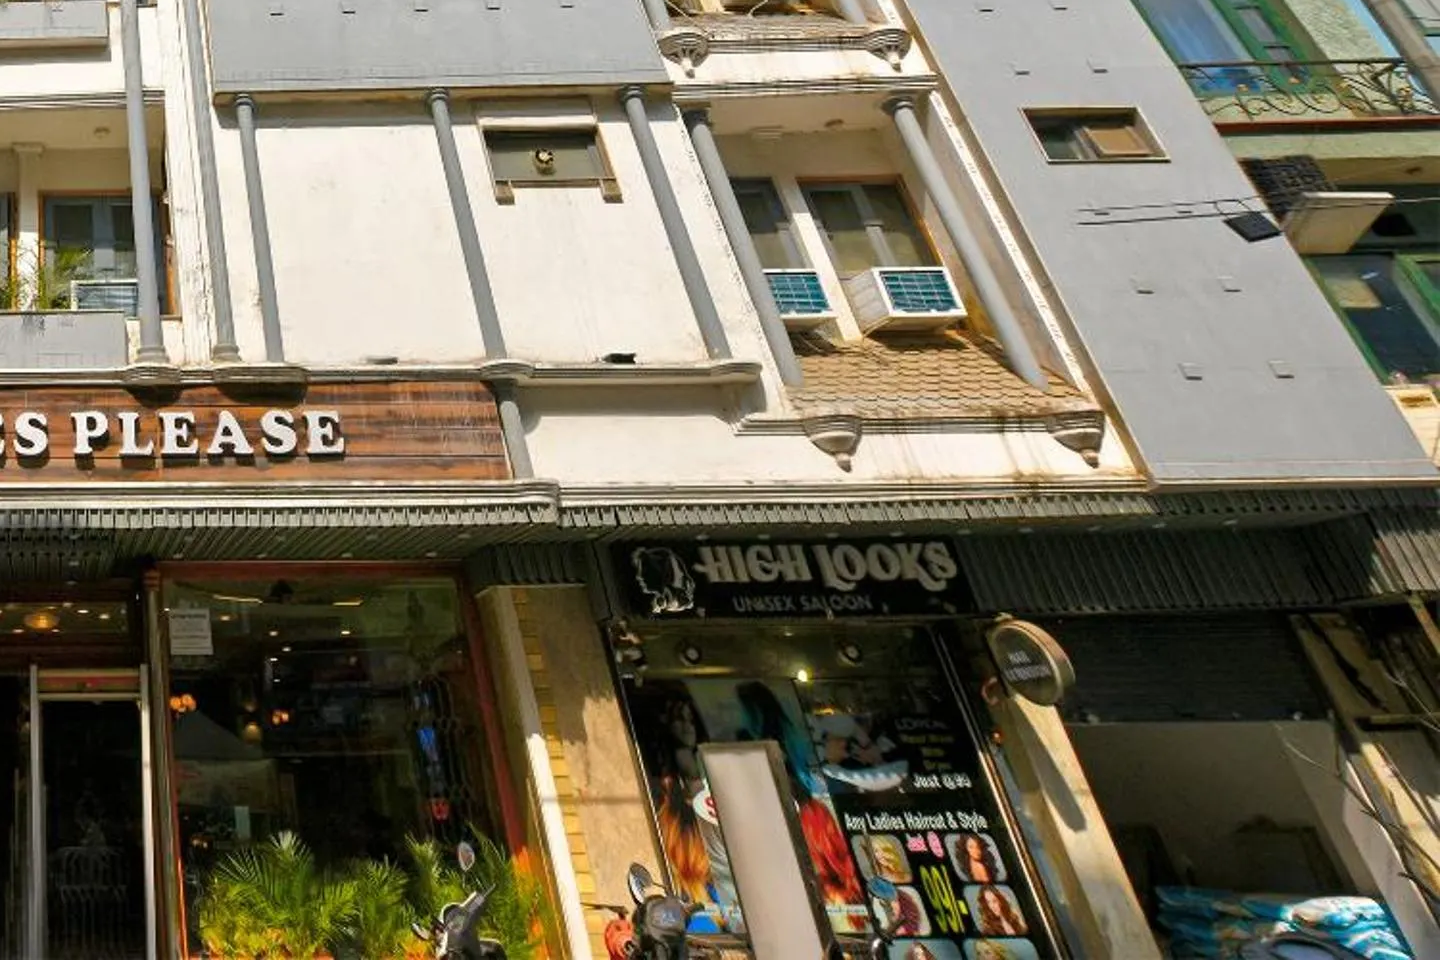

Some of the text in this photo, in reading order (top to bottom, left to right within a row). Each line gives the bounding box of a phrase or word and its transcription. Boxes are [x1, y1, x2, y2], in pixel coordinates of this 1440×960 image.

[70, 410, 344, 456] PLEASE
[693, 541, 957, 591] HIGH LOOKS
[732, 594, 874, 613] UNISEX SALOON
[865, 812, 905, 830] Ladies
[903, 811, 947, 829] Haircut
